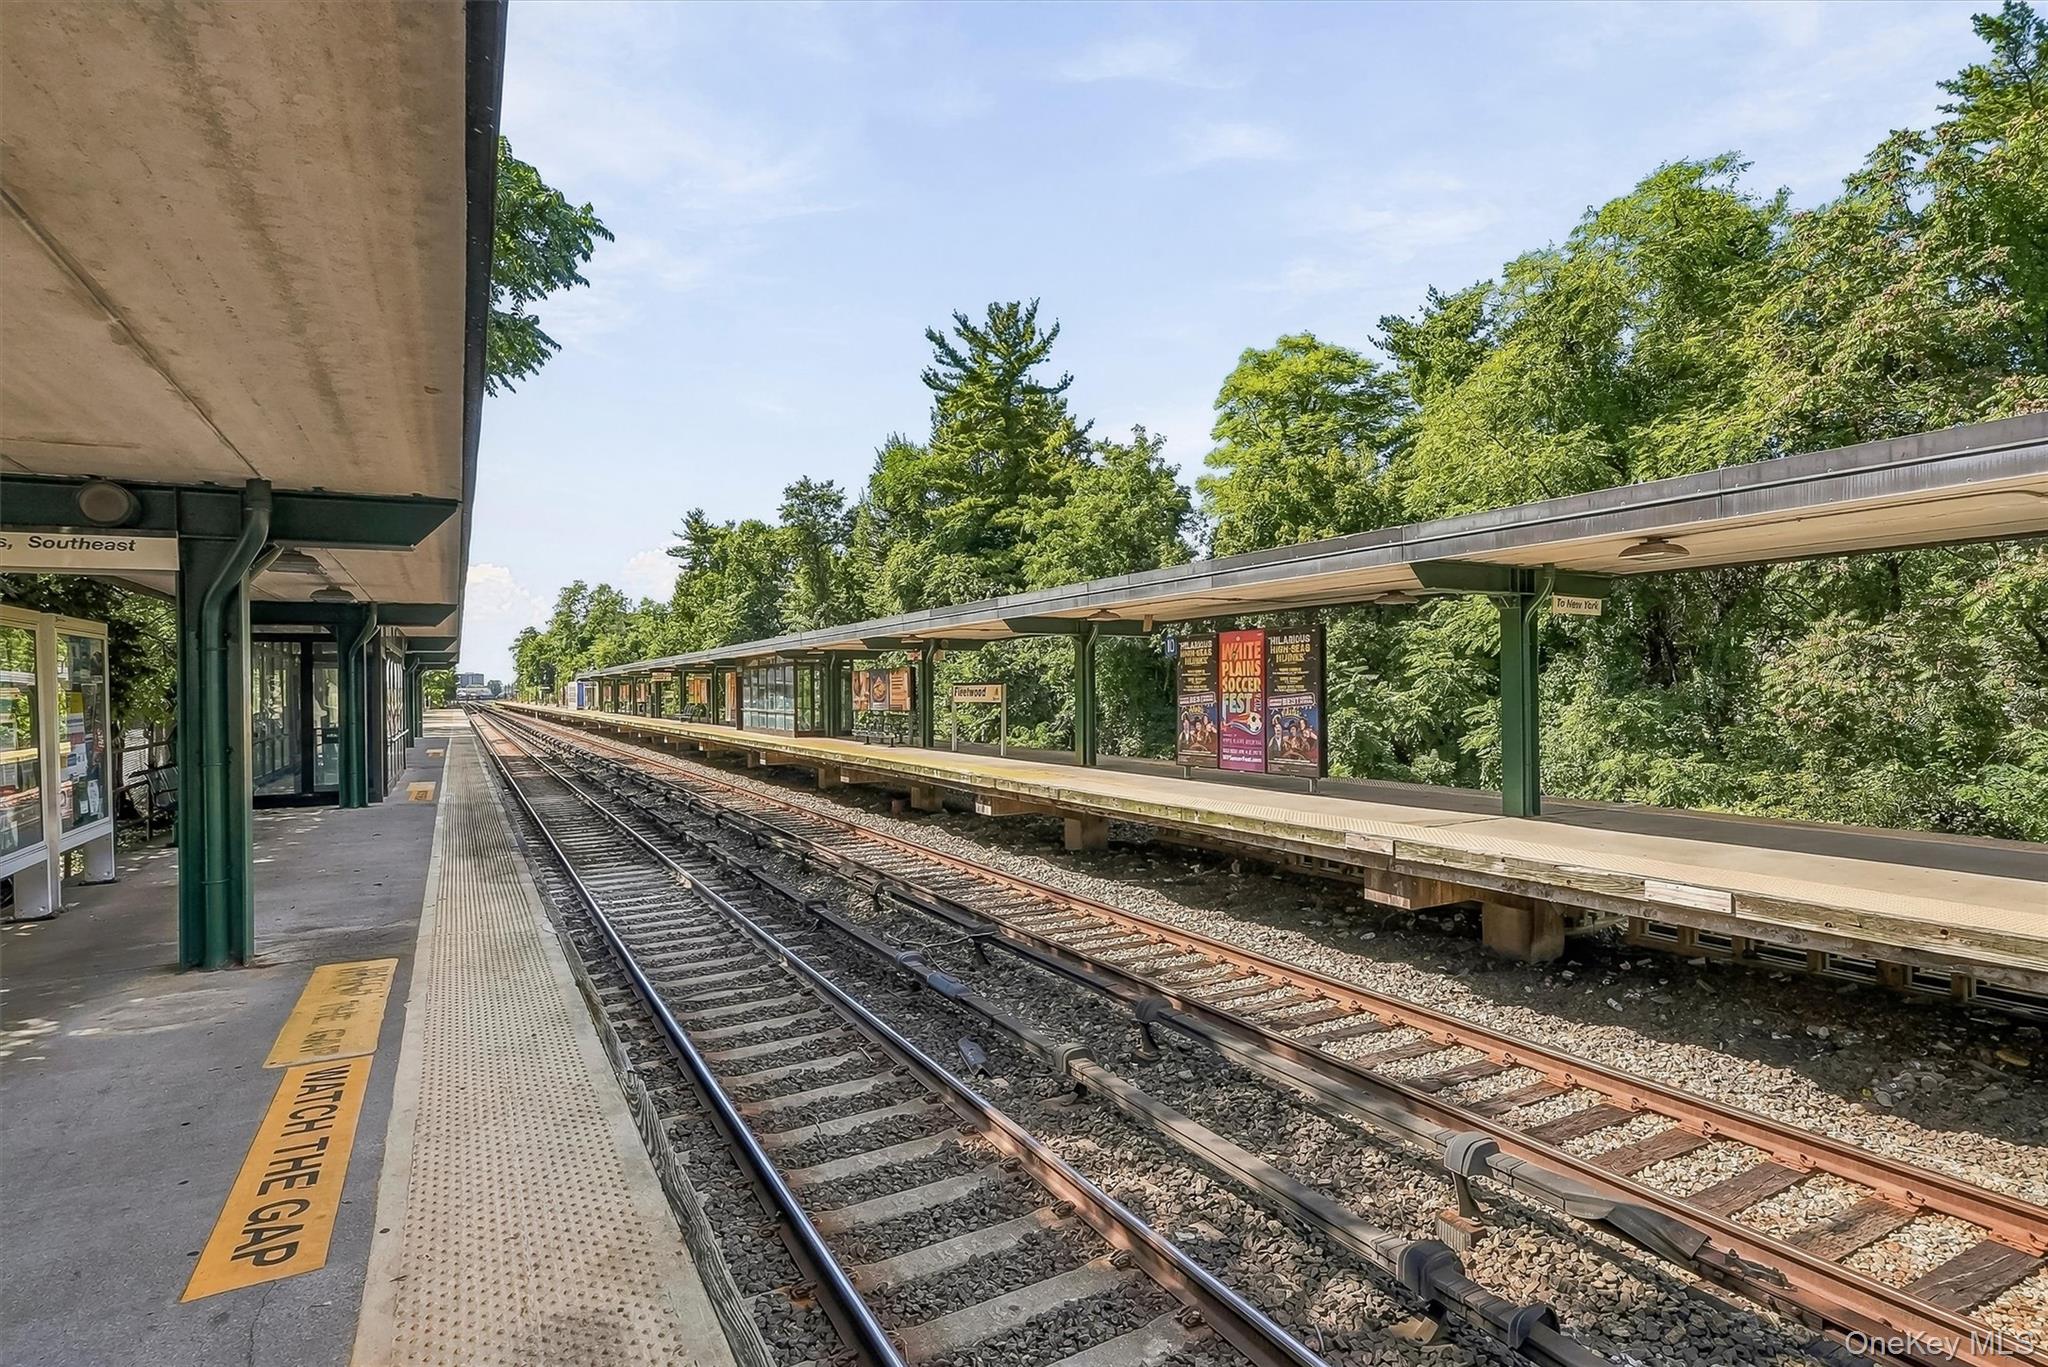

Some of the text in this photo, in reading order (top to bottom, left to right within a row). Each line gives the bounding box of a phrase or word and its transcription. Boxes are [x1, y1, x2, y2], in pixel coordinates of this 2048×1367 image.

[28, 535, 136, 552] Southeast
[1557, 598, 1598, 609] To New York
[1221, 660, 1261, 677] PLAINS
[954, 686, 987, 697] Fleetwood
[1222, 676, 1261, 692] SOCCER
[1222, 692, 1252, 717] FEST
[230, 1063, 352, 1267] WATCH THE GAP
